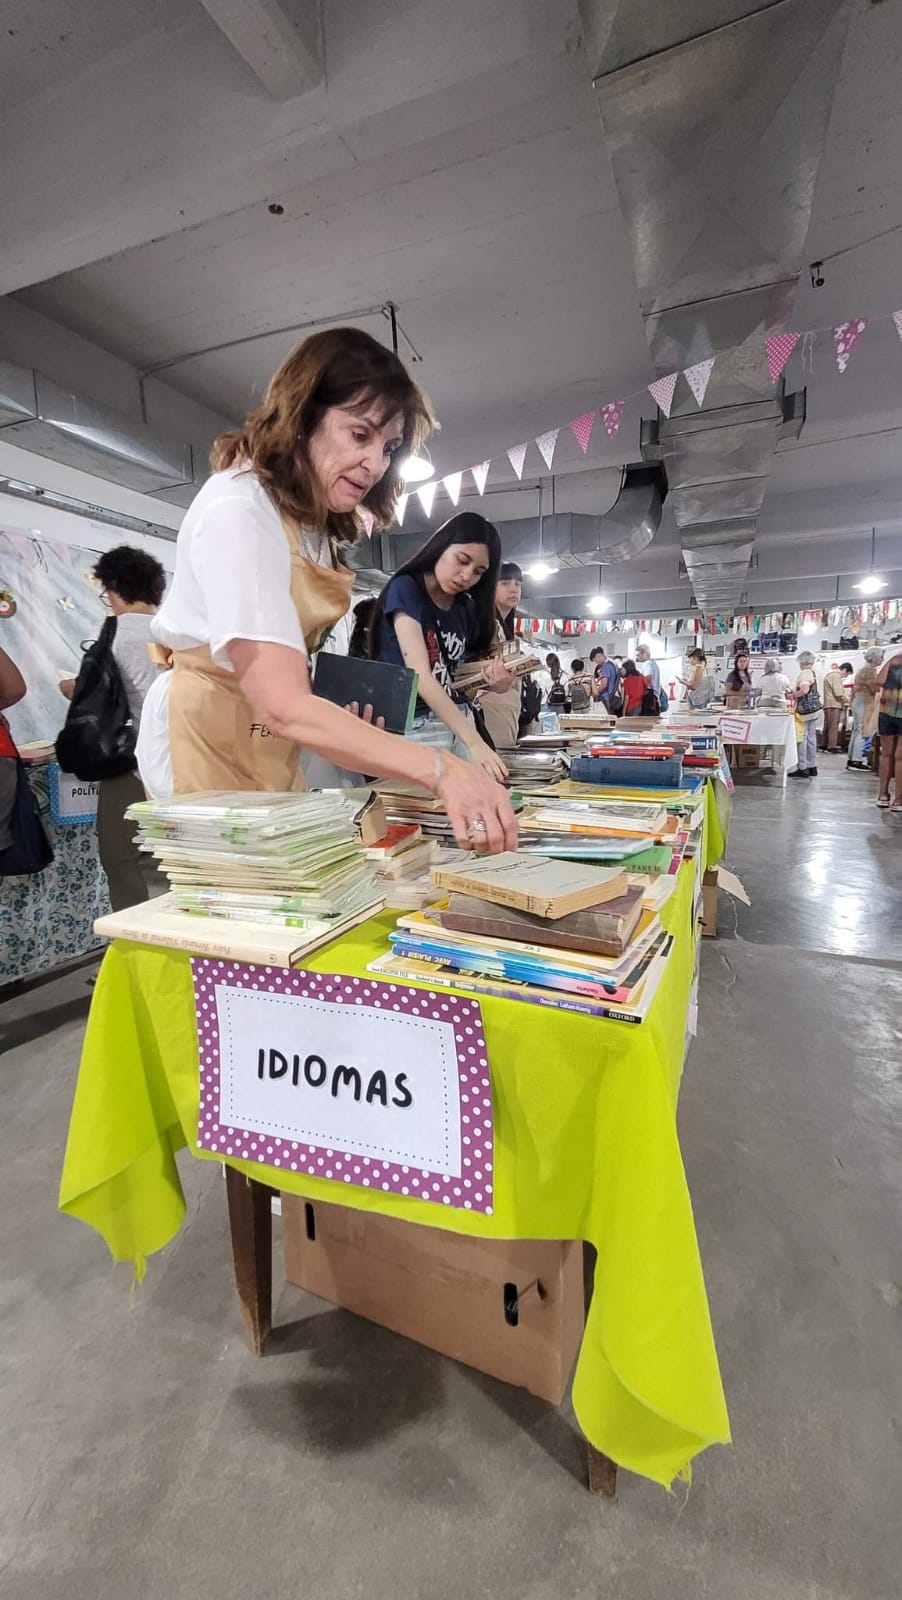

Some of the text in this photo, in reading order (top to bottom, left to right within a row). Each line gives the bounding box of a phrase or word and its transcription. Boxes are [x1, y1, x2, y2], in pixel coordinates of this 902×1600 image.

[407, 951, 432, 962] PLAISIR
[434, 956, 452, 966] AVEC
[608, 1010, 635, 1022] OXFORD
[257, 1048, 413, 1108] IDIOMAS
